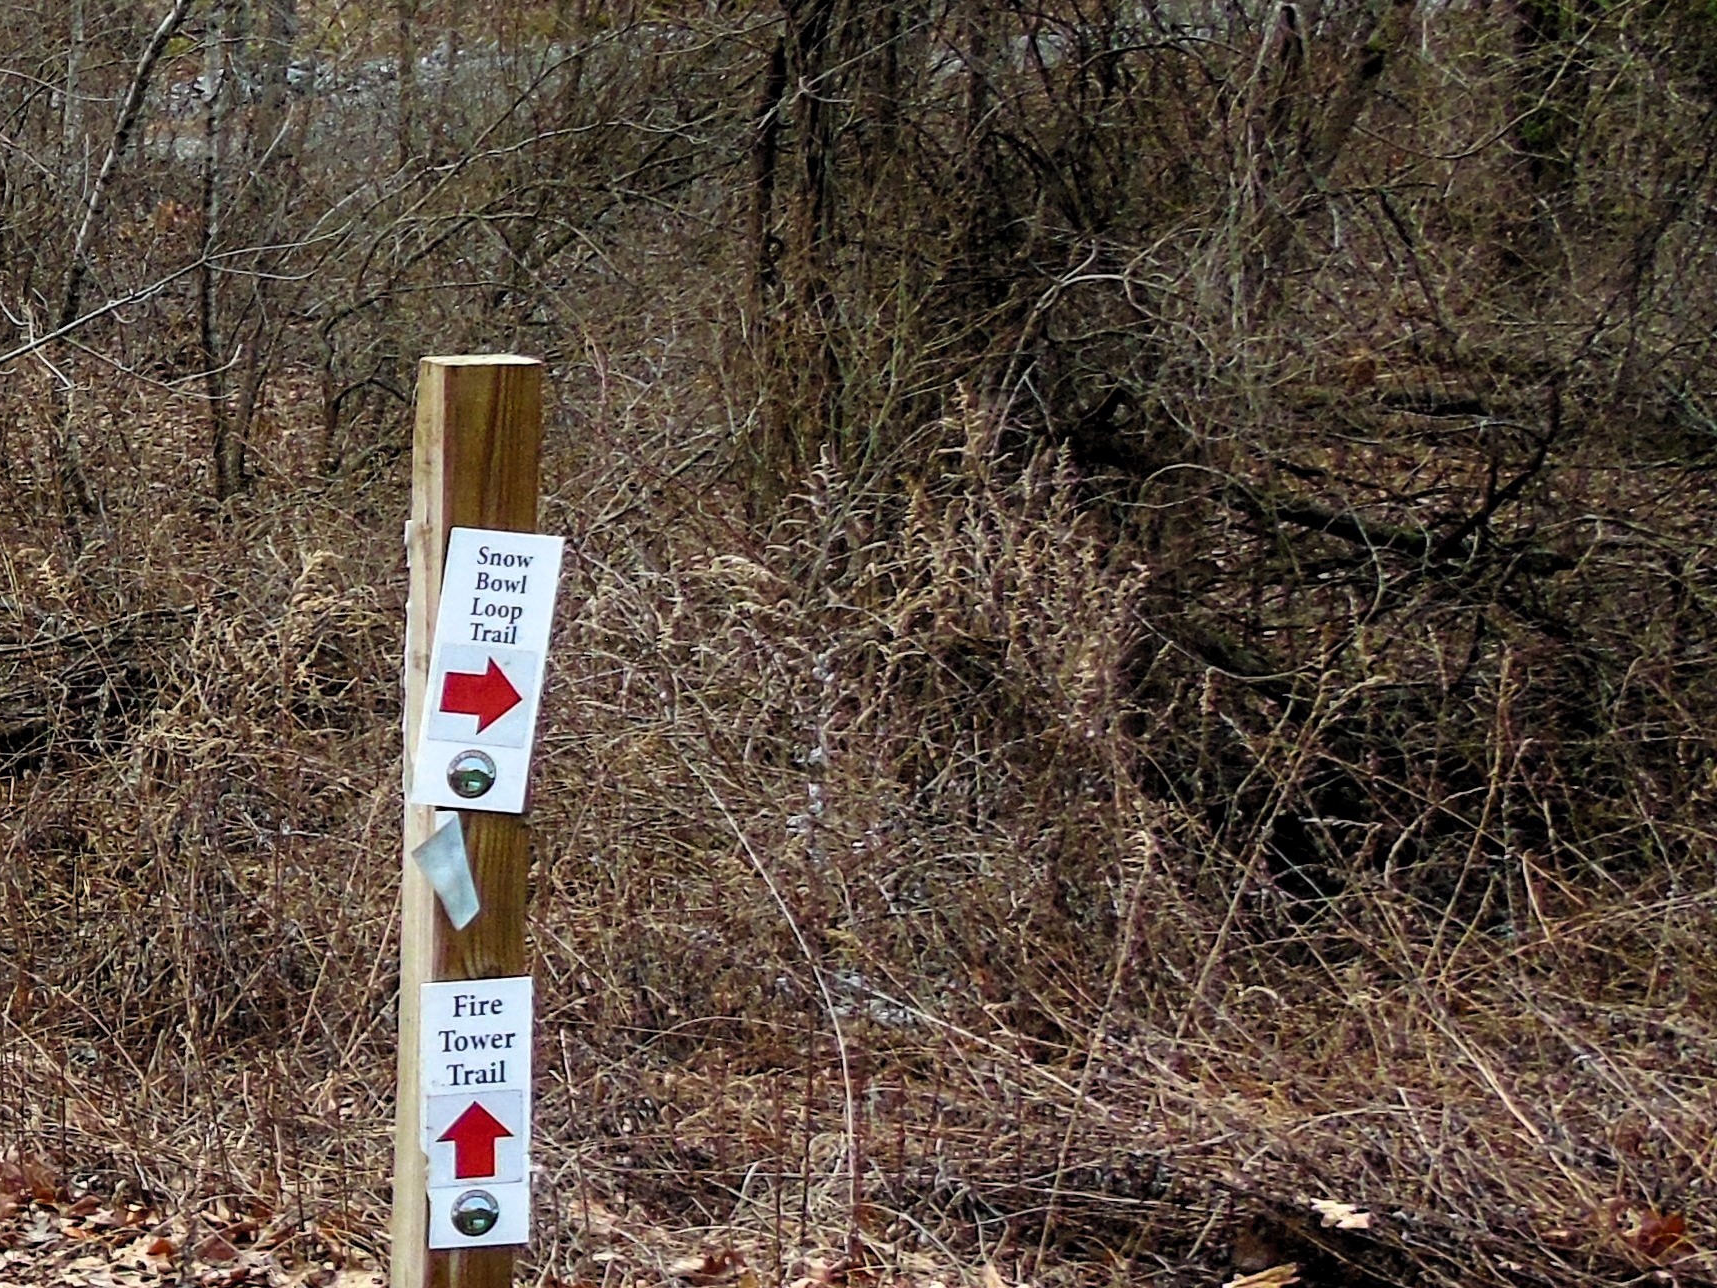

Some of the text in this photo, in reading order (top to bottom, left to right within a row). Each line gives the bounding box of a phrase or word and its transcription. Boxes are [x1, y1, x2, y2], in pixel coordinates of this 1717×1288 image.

[477, 546, 533, 568] Snow
[475, 572, 527, 594] Bowl
[470, 597, 523, 624] Loop
[470, 623, 517, 645] Trail
[452, 995, 503, 1017] Fire
[439, 1030, 516, 1052] Tower
[446, 1060, 506, 1086] Trail
